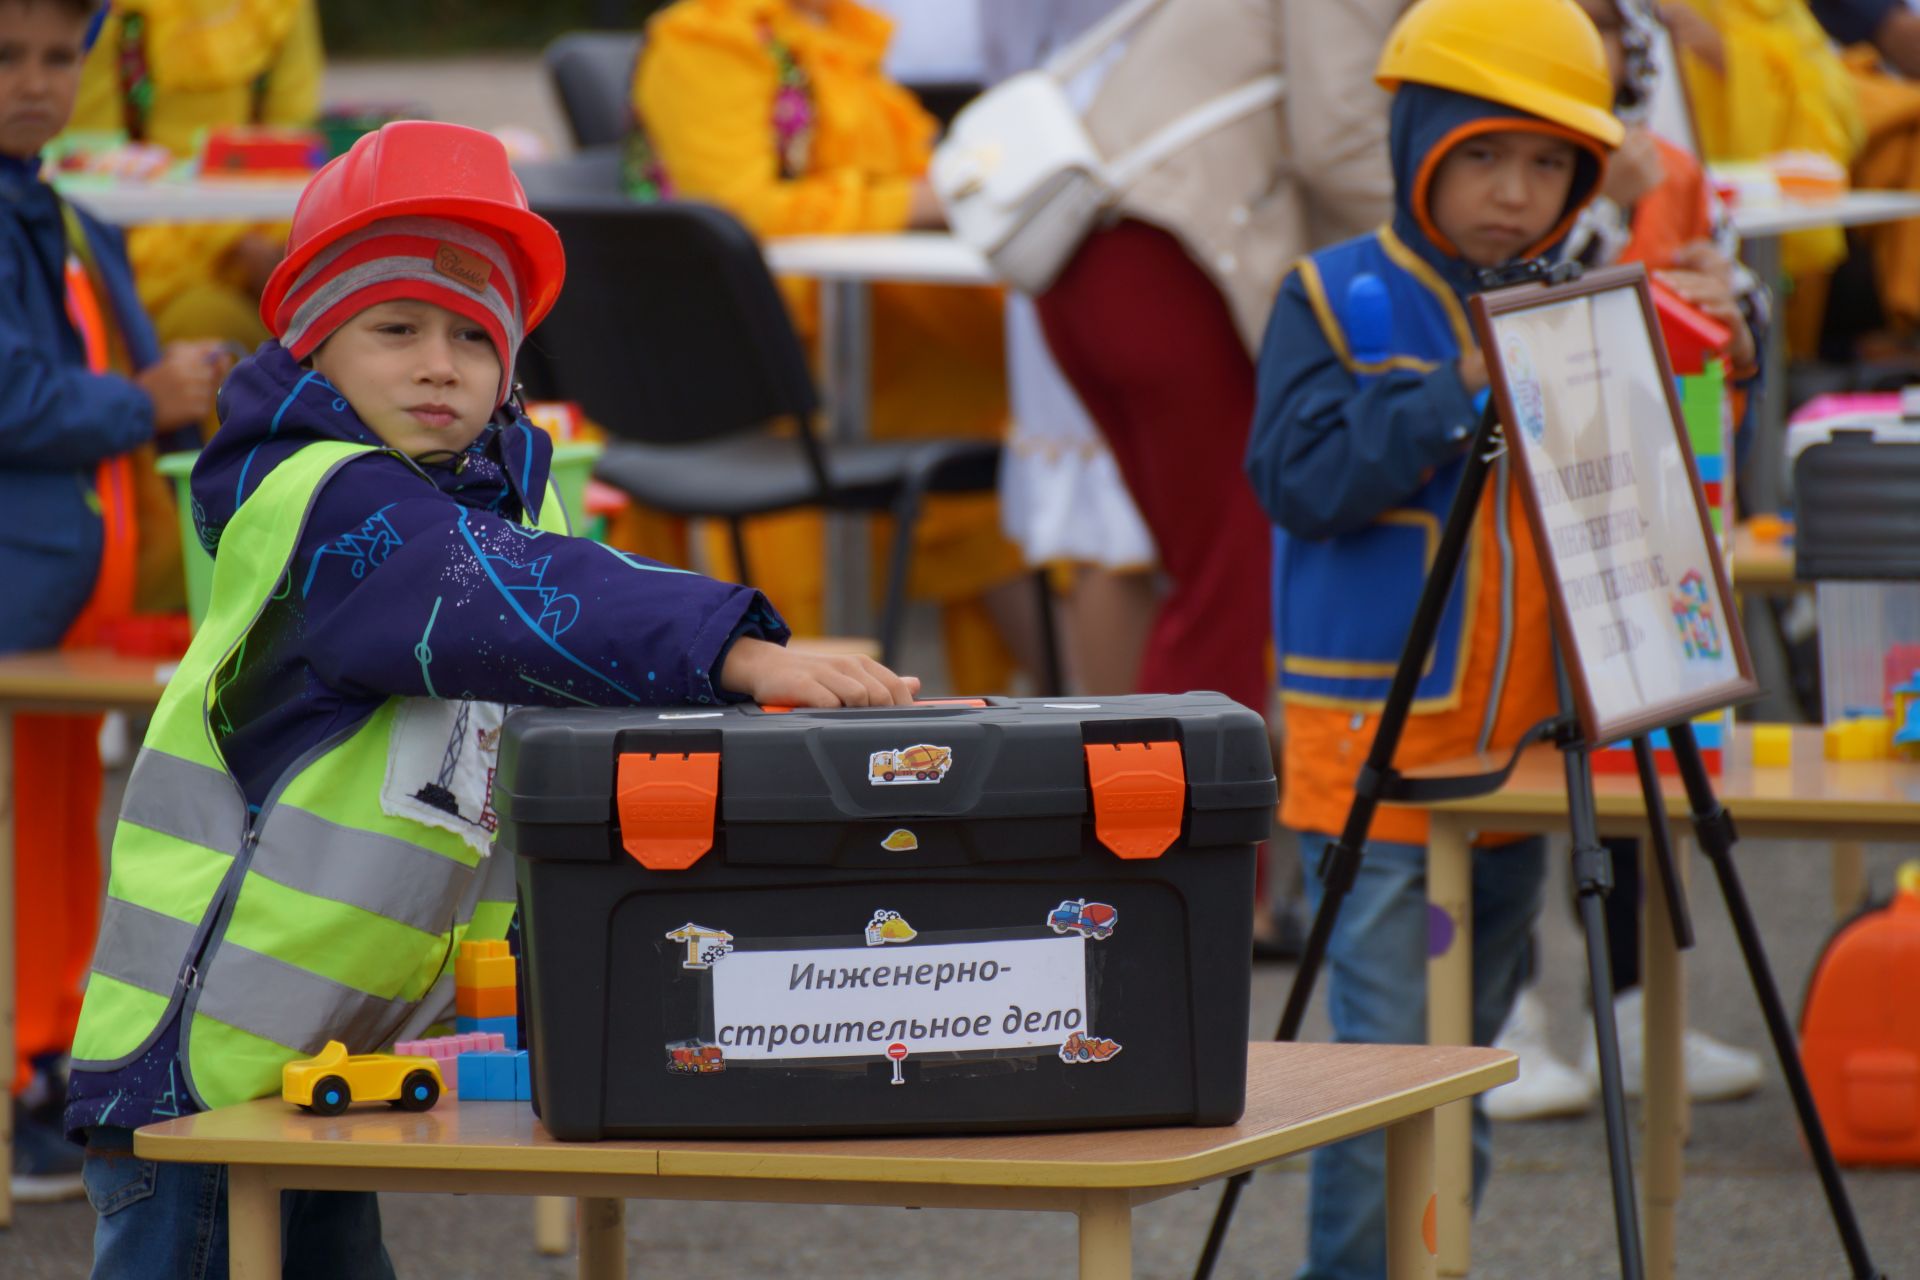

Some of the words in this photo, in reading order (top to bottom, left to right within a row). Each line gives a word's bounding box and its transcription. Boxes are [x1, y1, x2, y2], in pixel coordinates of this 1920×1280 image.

[789, 959, 1012, 990] Инженерно-
[718, 1012, 992, 1052] строительное
[1002, 1005, 1082, 1035] дело
